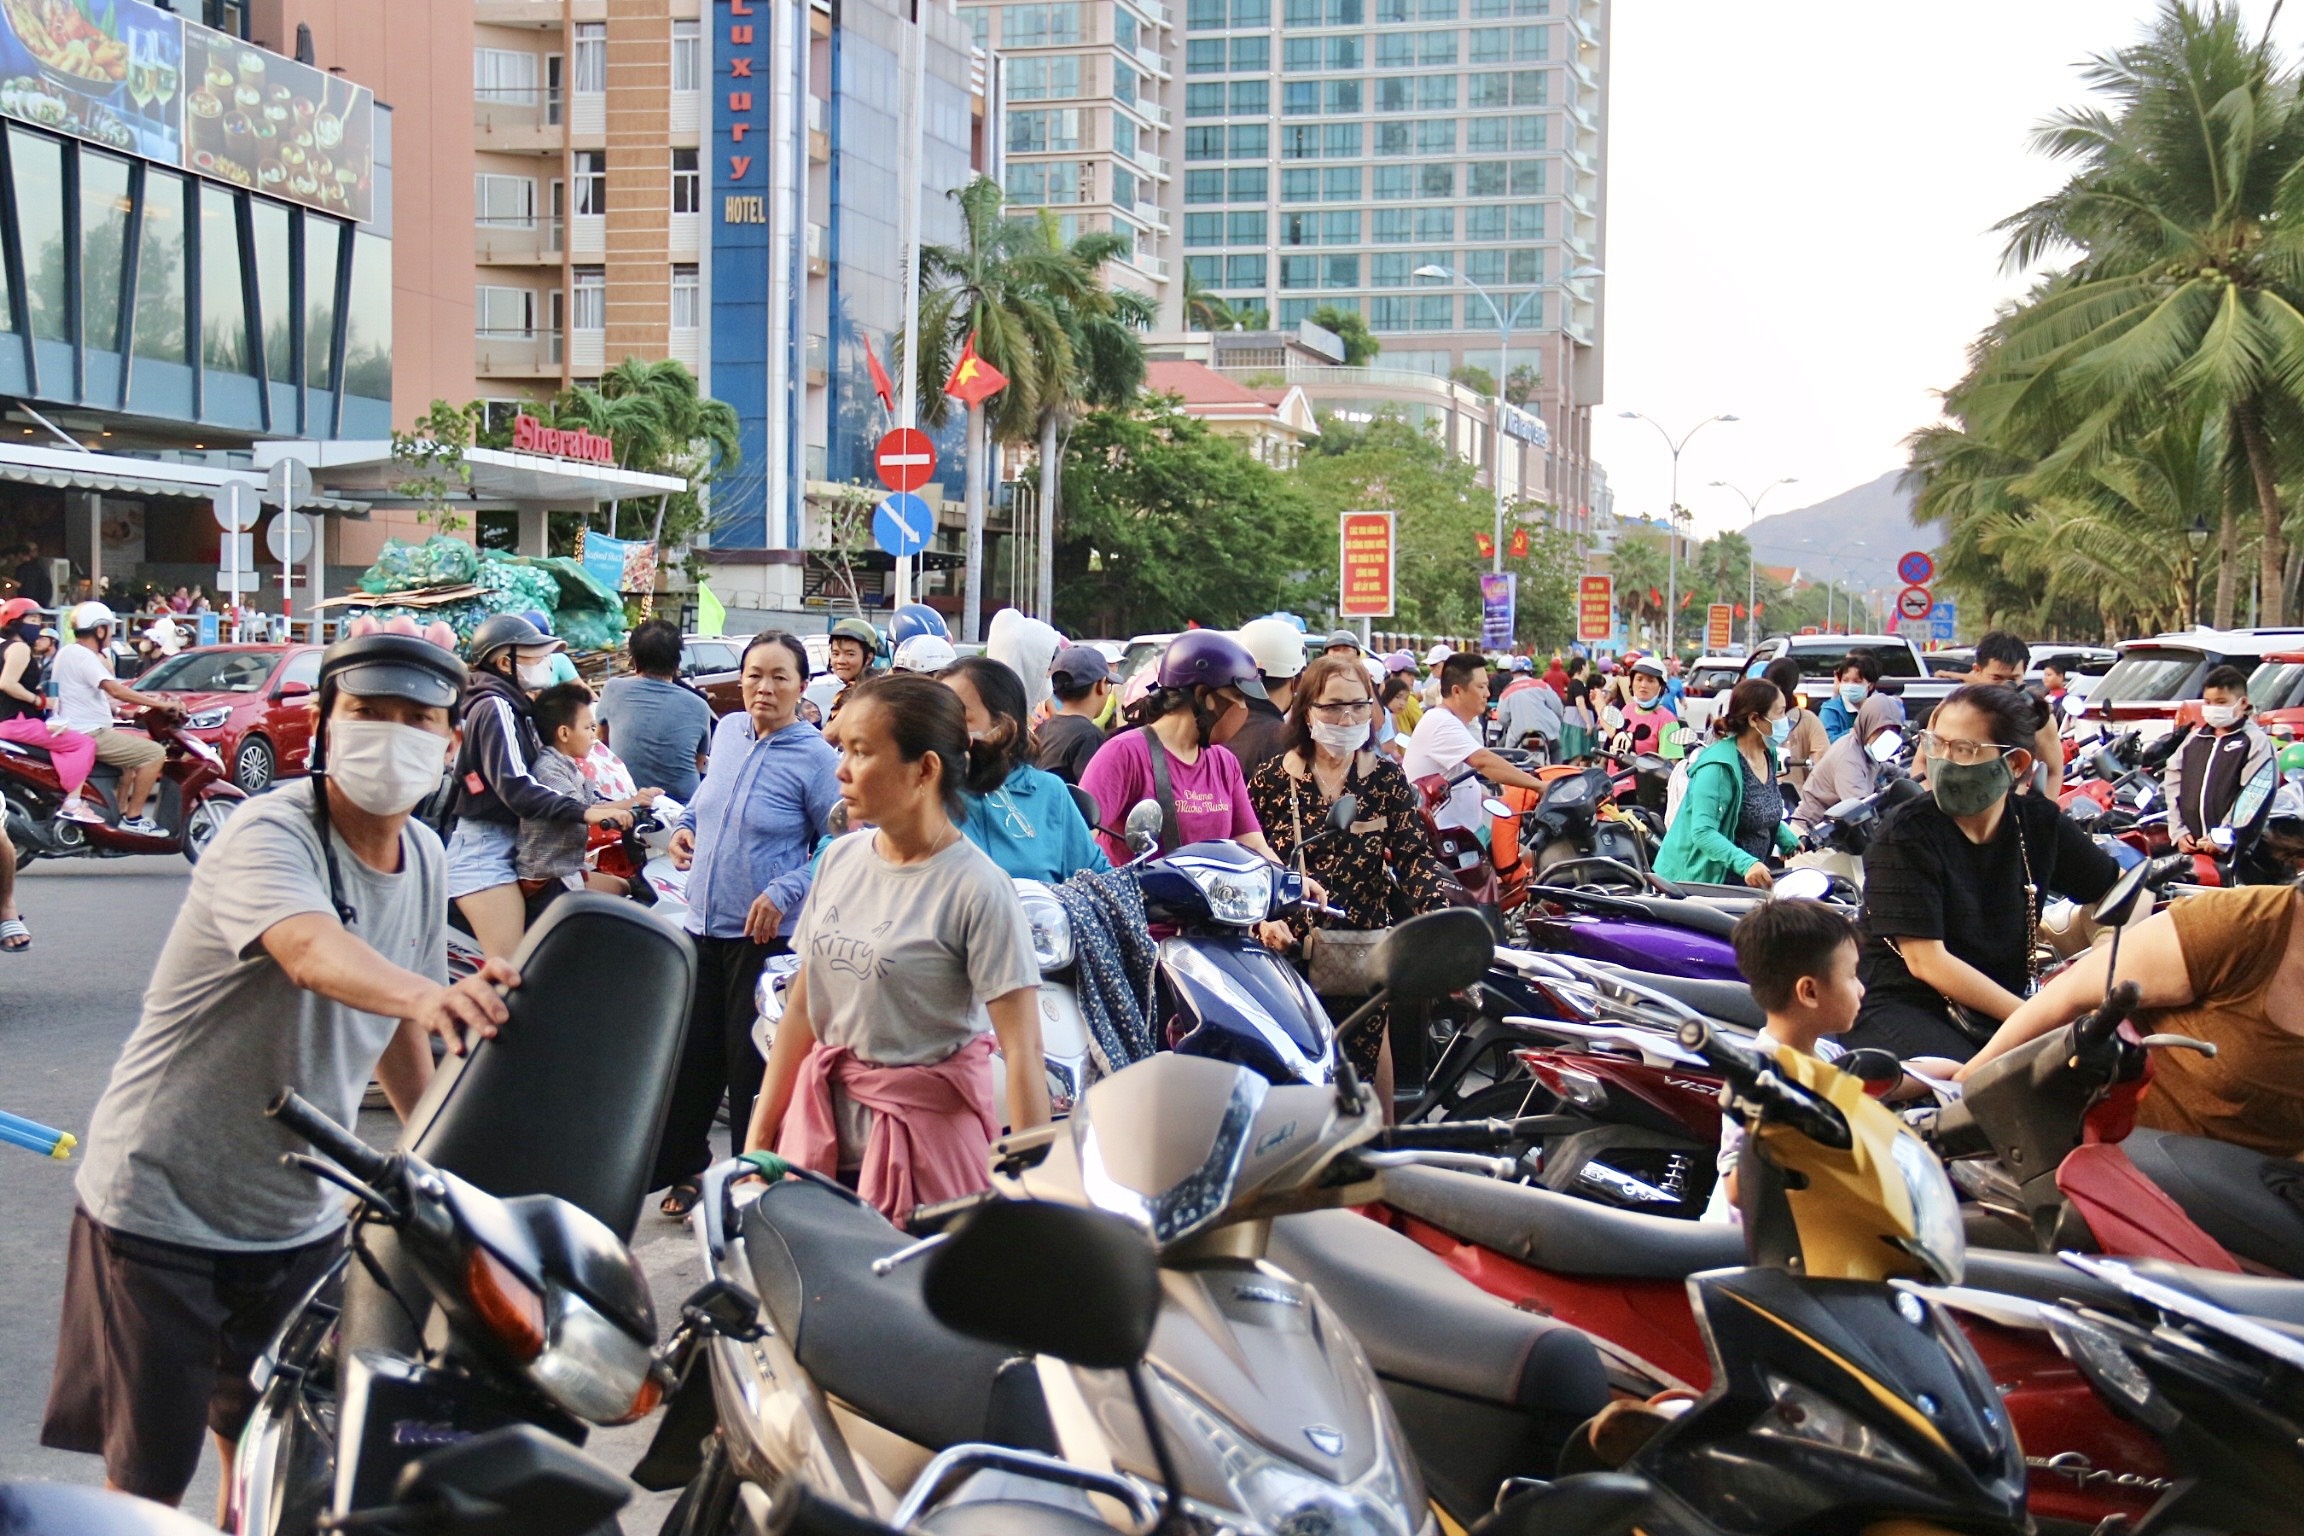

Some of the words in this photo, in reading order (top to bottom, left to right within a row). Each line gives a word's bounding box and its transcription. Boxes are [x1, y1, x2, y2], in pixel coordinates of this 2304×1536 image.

[729, 0, 753, 180] Luxury
[725, 195, 766, 224] HOTEL
[513, 414, 613, 462] Sheraton
